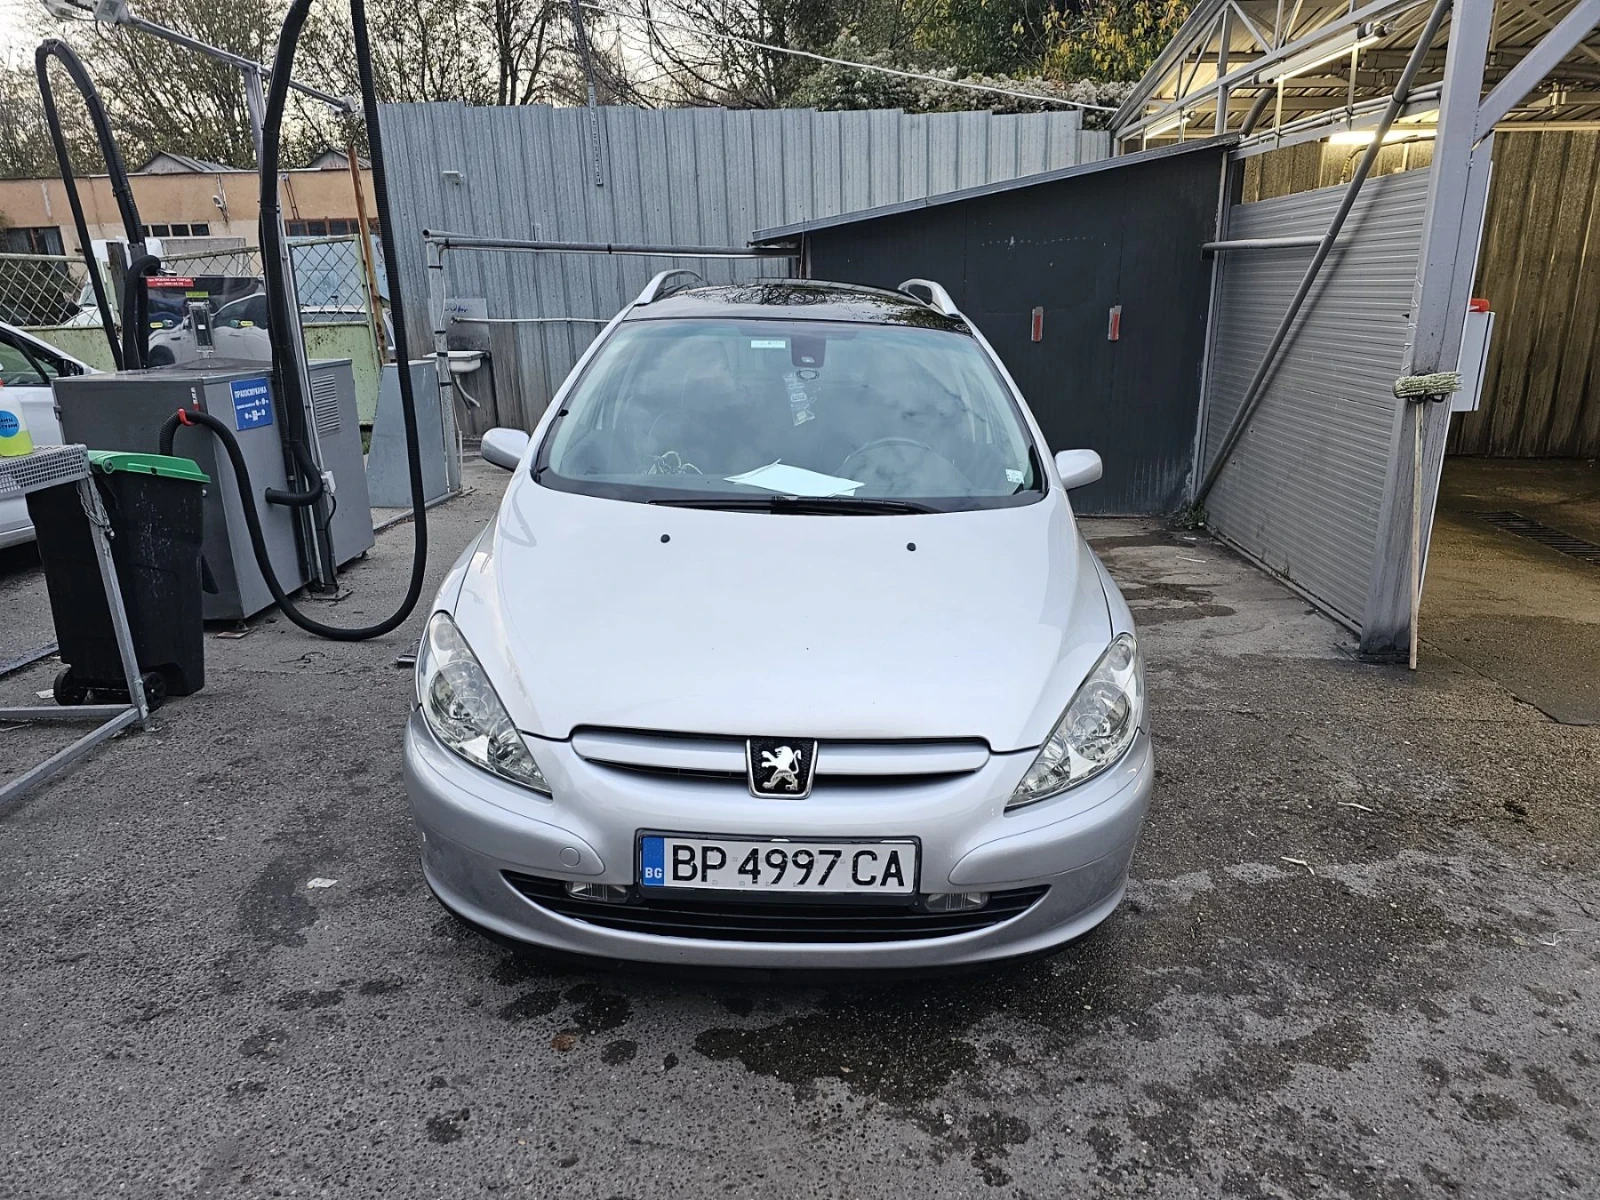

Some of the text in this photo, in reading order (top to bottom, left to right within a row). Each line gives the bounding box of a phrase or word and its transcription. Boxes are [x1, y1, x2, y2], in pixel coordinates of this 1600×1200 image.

[645, 867, 663, 879] BG
[672, 844, 905, 887] BP 4997 CA
